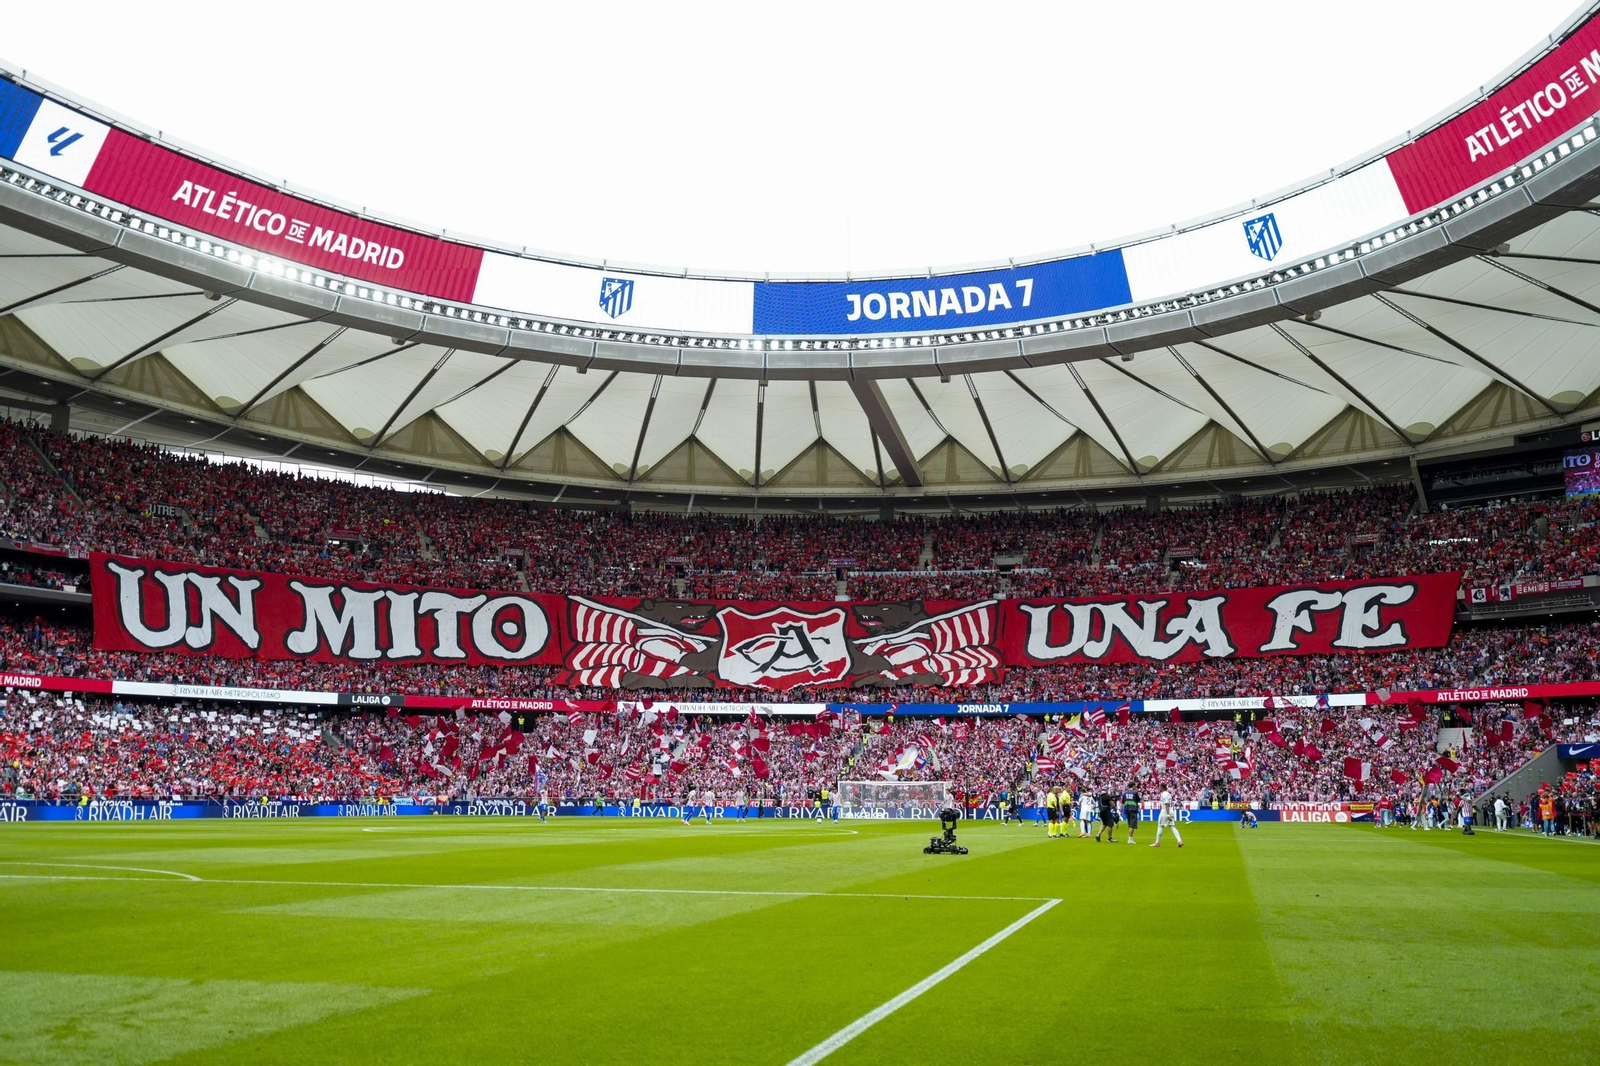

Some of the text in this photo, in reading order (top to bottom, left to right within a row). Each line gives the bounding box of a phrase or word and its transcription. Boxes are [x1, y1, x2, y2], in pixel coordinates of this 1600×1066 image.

[1464, 82, 1567, 162] ATLÉTICO
[1565, 72, 1585, 93] DE
[172, 180, 404, 268] ATLÉTICO DE MADRID
[846, 278, 1034, 322] JORNADA 7
[107, 561, 549, 660] UN MITO
[1019, 584, 1415, 660] UNA FE
[4, 675, 42, 687] MADRID
[180, 687, 208, 696] RIYADH
[224, 690, 281, 700] METROPOLITANO
[352, 695, 381, 704] LALIGA
[1437, 689, 1480, 701] ATLÉTICO
[1490, 688, 1529, 698] MADRID
[471, 698, 510, 708] ATLÉTICO
[520, 701, 553, 709] MADRID
[957, 704, 1010, 713] JORNADA 7
[89, 806, 173, 820] RIYADH AIR
[233, 805, 300, 818] RIYADH AIR
[346, 804, 397, 817] RIYADH AIR
[468, 806, 557, 816] RIYADH AR
[698, 807, 724, 818] AR
[1282, 811, 1331, 823] LALIGA
